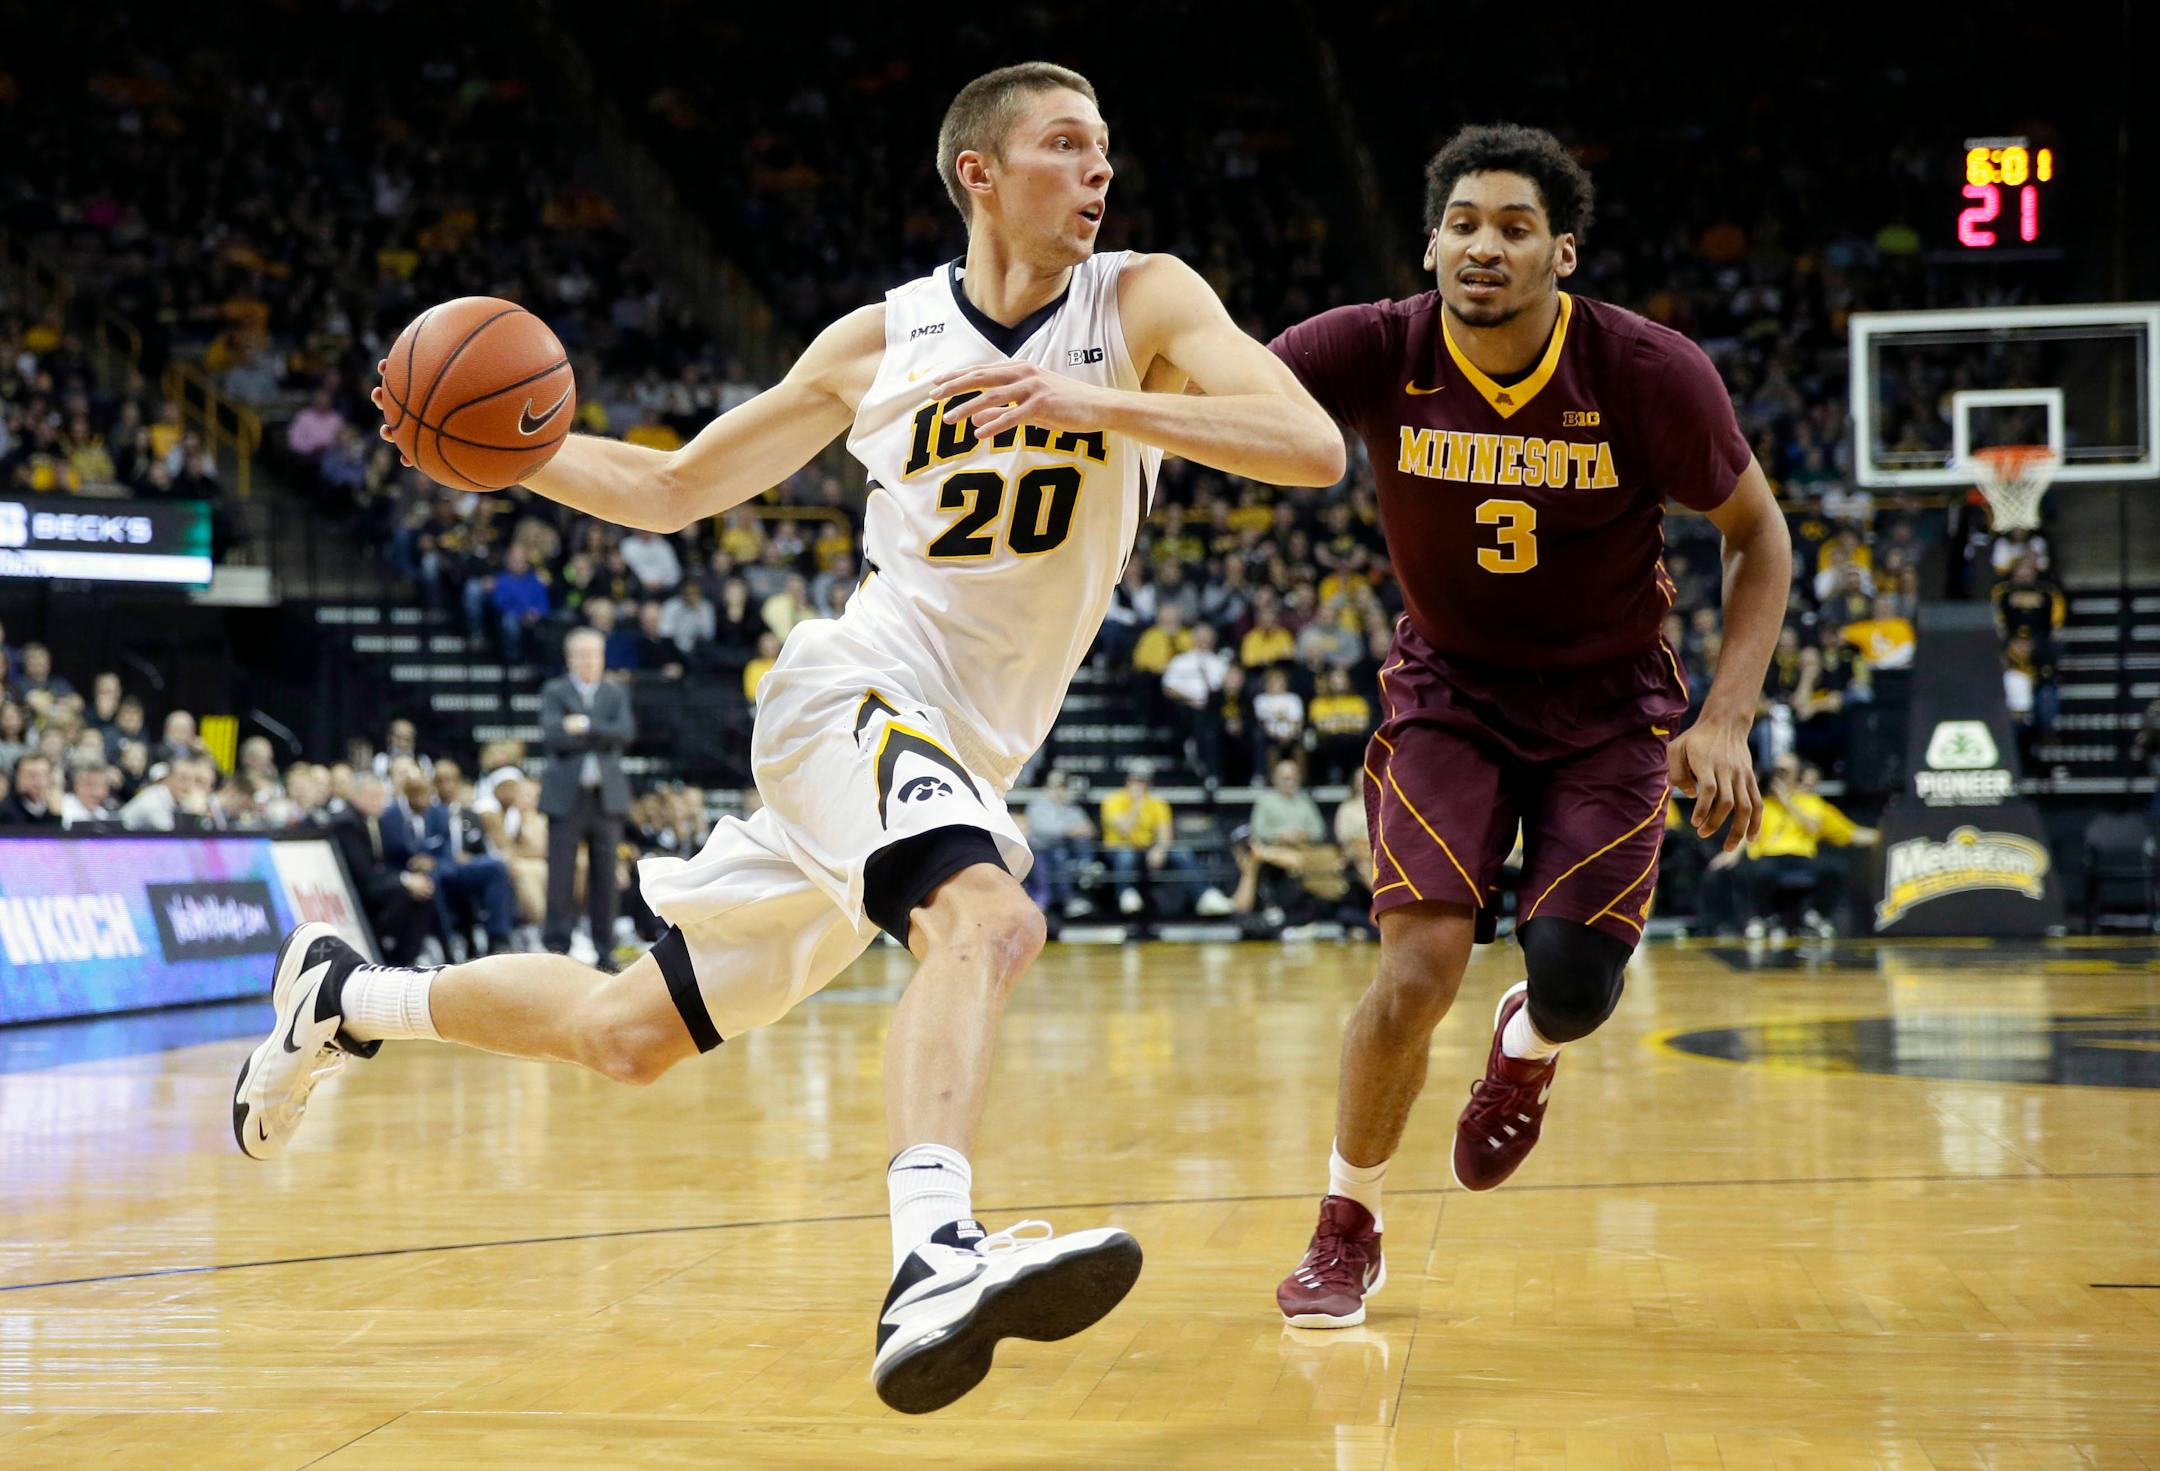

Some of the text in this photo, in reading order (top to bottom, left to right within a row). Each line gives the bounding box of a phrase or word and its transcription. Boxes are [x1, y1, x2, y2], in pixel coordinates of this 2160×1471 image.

[1958, 183, 2038, 247] 21
[910, 322, 945, 341] RM23
[1398, 425, 1619, 490] MINNESOTA
[925, 463, 1086, 560] 20
[1475, 498, 1538, 574] 3
